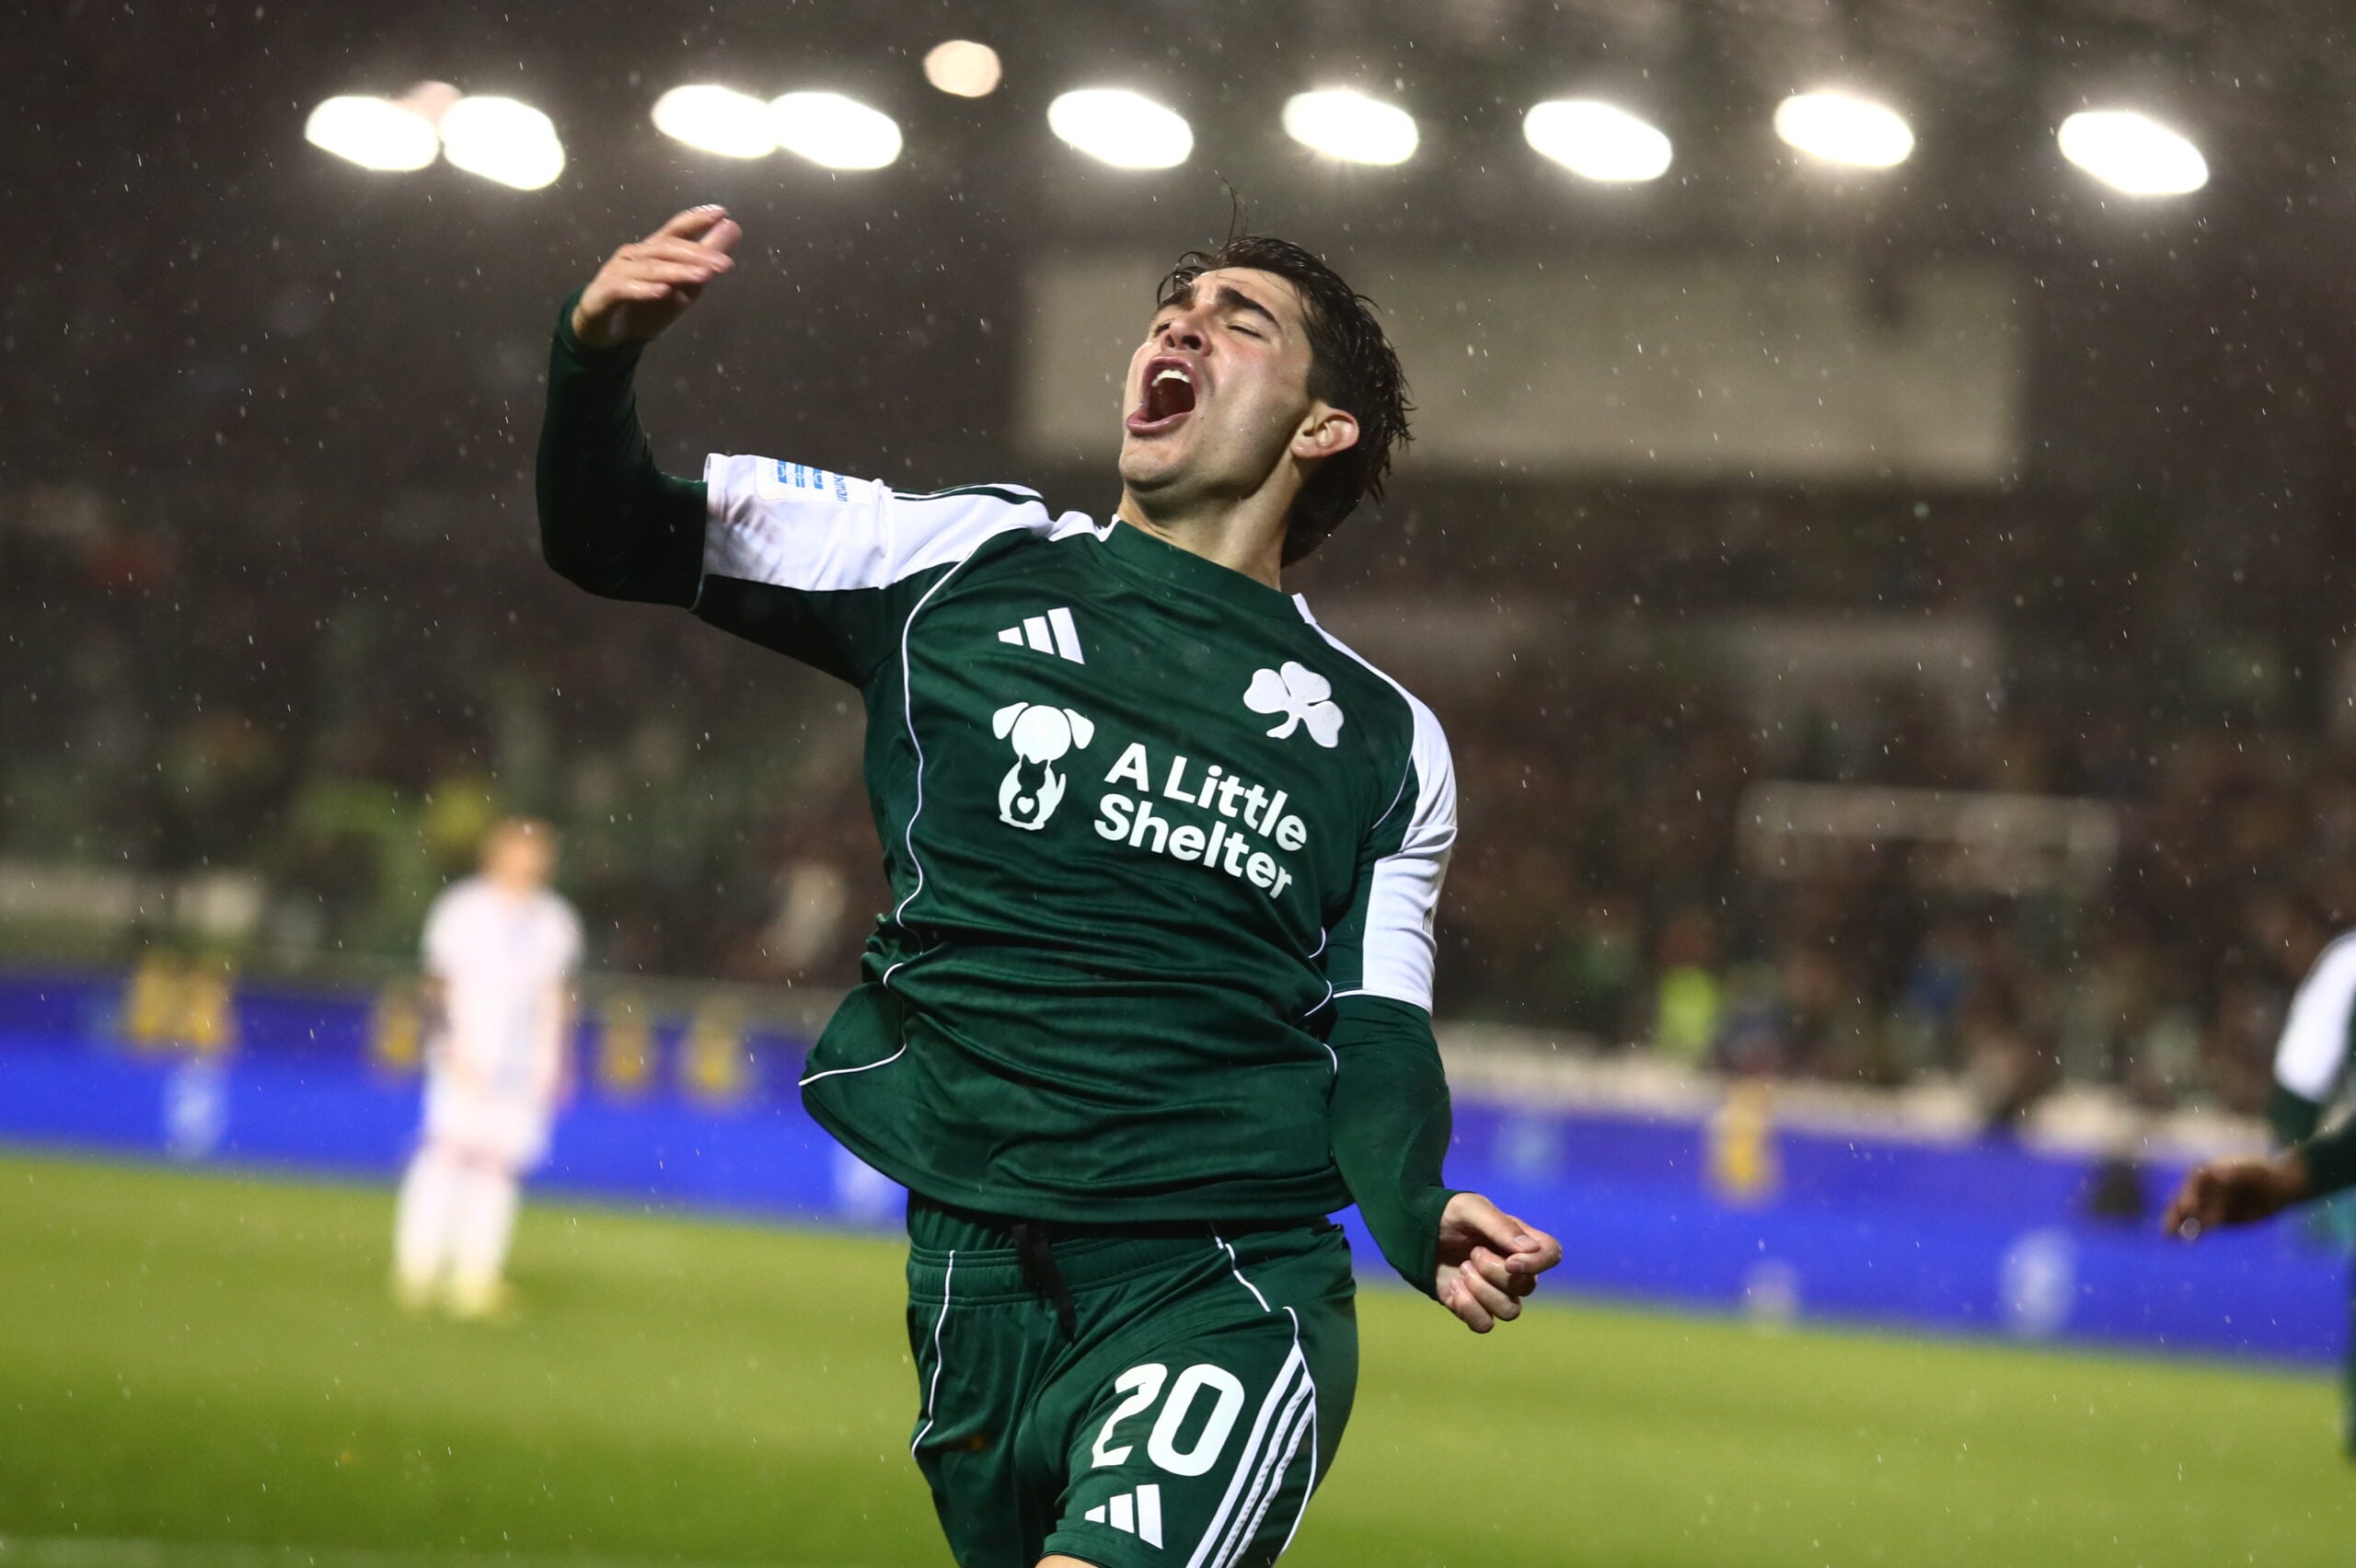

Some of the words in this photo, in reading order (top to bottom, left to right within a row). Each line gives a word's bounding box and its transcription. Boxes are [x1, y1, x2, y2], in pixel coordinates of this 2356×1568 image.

[1093, 792, 1293, 899] Shelter
[1103, 742, 1149, 792] A
[1162, 755, 1308, 852] Little
[1091, 1363, 1245, 1477] 20
